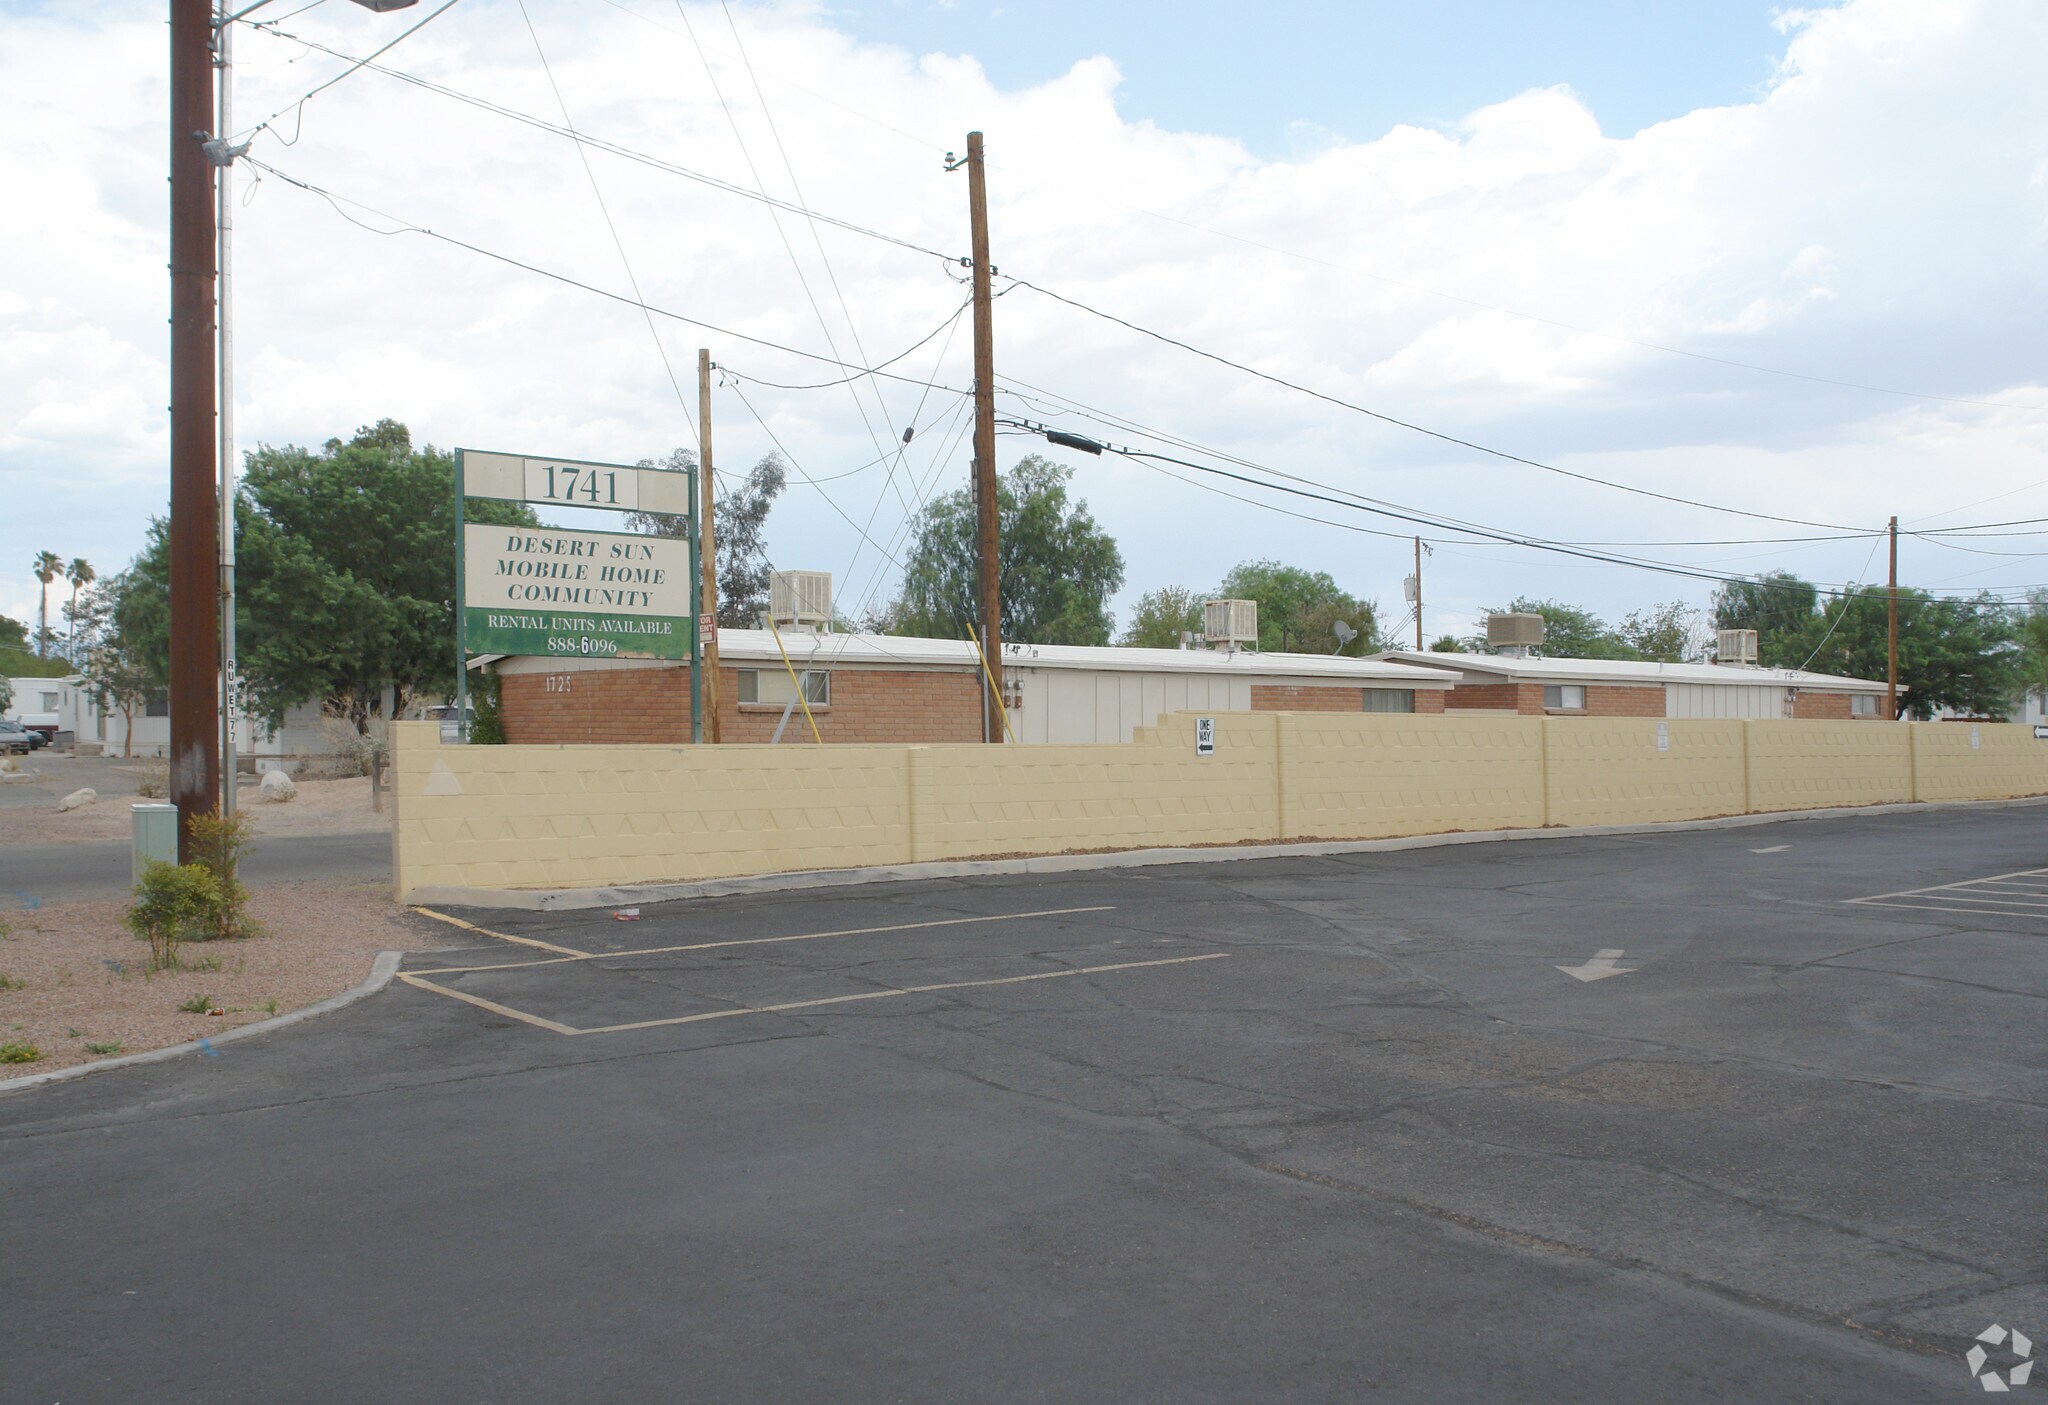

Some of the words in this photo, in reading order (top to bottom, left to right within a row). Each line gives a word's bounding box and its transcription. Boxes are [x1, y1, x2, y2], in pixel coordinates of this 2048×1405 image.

[541, 465, 620, 504] 1741
[506, 535, 600, 557] DESERT
[609, 543, 655, 560] SUN
[494, 559, 589, 580] MOBILE
[600, 566, 666, 585] HOME
[507, 584, 654, 607] COMMUNITY
[488, 614, 548, 630] RENTAL
[552, 617, 596, 631] UNITS
[598, 619, 672, 635] AVAILABLE
[547, 635, 617, 655] 888-6096
[546, 675, 572, 692] 1725
[1200, 719, 1210, 731] ONE
[1199, 730, 1211, 742] WAY
